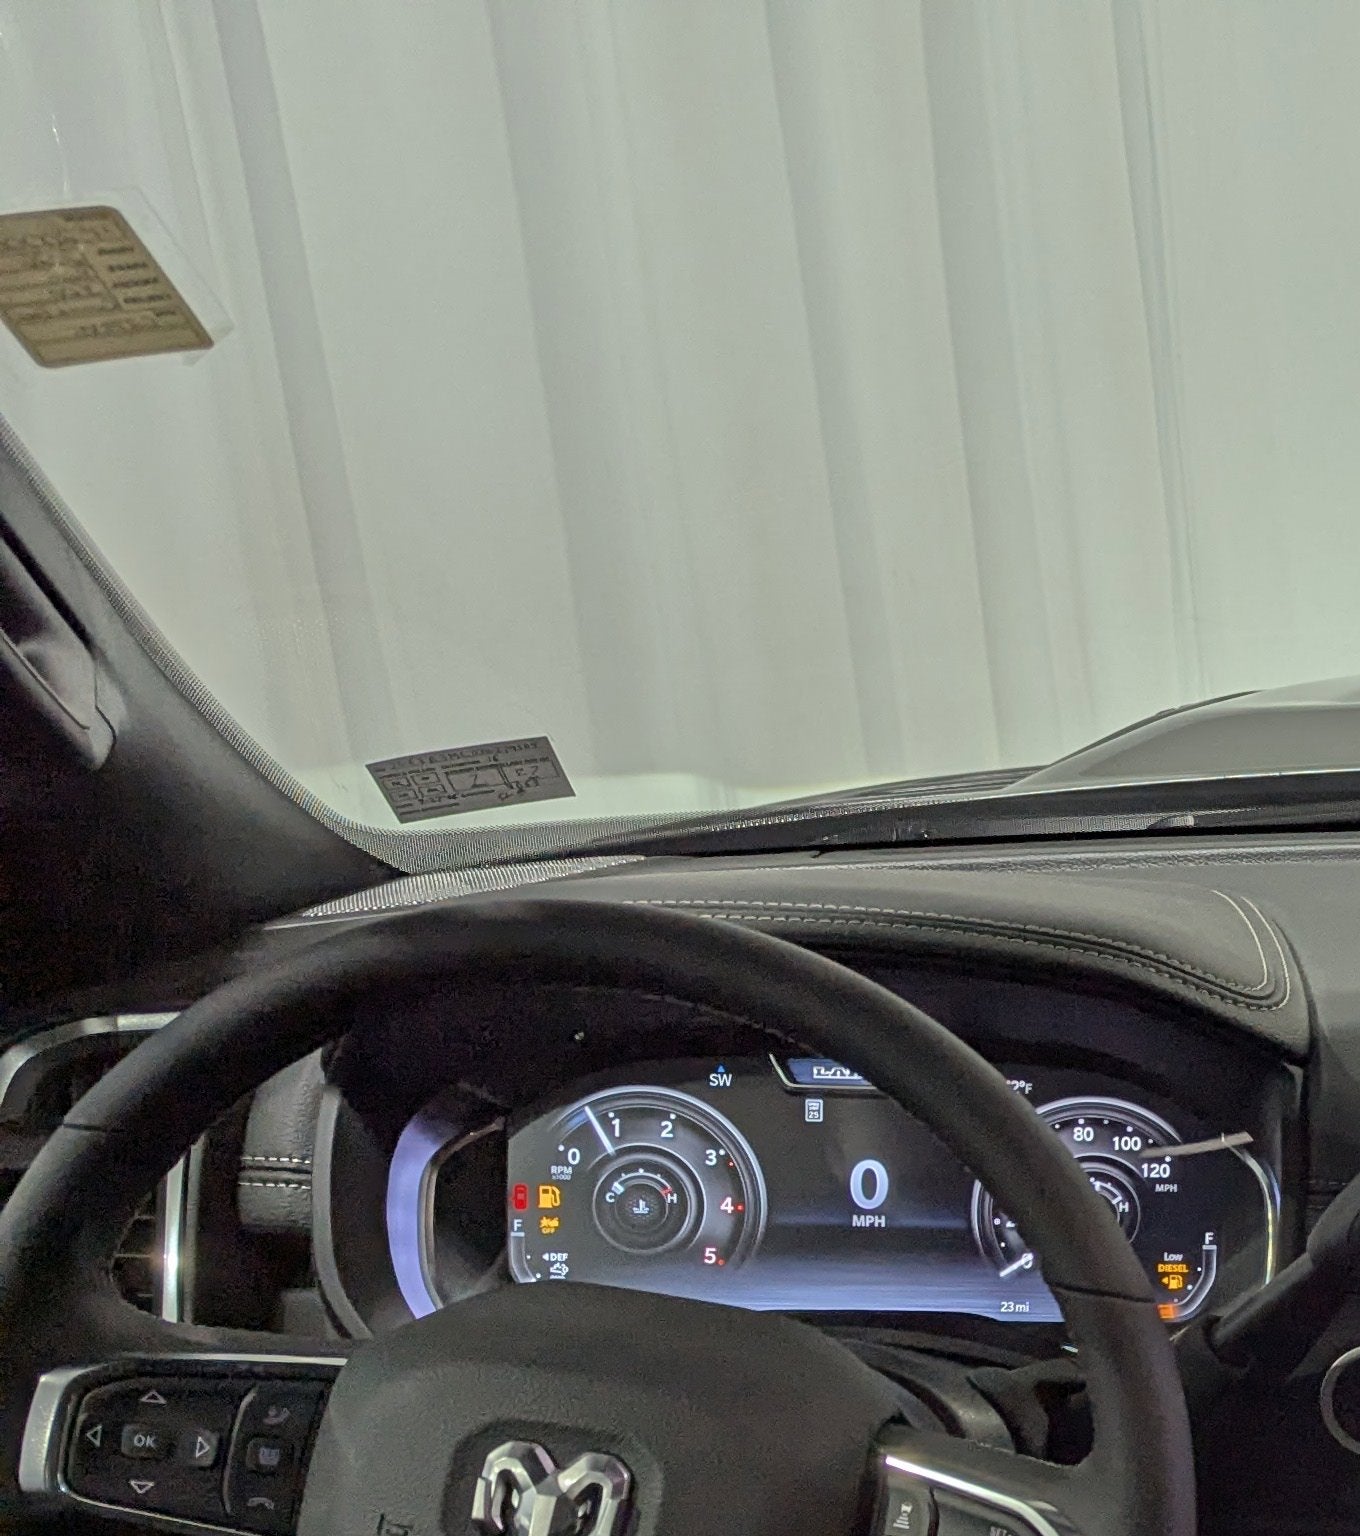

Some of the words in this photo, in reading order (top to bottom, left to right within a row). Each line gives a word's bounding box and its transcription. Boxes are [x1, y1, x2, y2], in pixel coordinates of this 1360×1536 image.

[709, 1073, 732, 1087] SW
[611, 1118, 621, 1137] 1
[661, 1121, 673, 1137] 2
[1073, 1127, 1094, 1141] 80
[1112, 1136, 1142, 1151] 100
[568, 1148, 581, 1164] 0
[705, 1150, 717, 1165] 3
[551, 1166, 573, 1175] RPM
[1141, 1163, 1171, 1178] 120
[850, 1159, 889, 1210] 0
[1155, 1184, 1178, 1192] MPH
[605, 1192, 616, 1203] C
[667, 1193, 677, 1203] H
[720, 1197, 734, 1213] 4
[1119, 1201, 1129, 1212] H
[514, 1219, 522, 1231] F
[852, 1215, 886, 1227] MPH
[1205, 1232, 1214, 1244] F
[704, 1248, 716, 1264] 5
[1164, 1252, 1183, 1261] Low
[1158, 1264, 1188, 1272] DIESEL
[1001, 1302, 1014, 1312] 23
[1016, 1301, 1029, 1312] mi
[133, 1435, 156, 1448] OK
